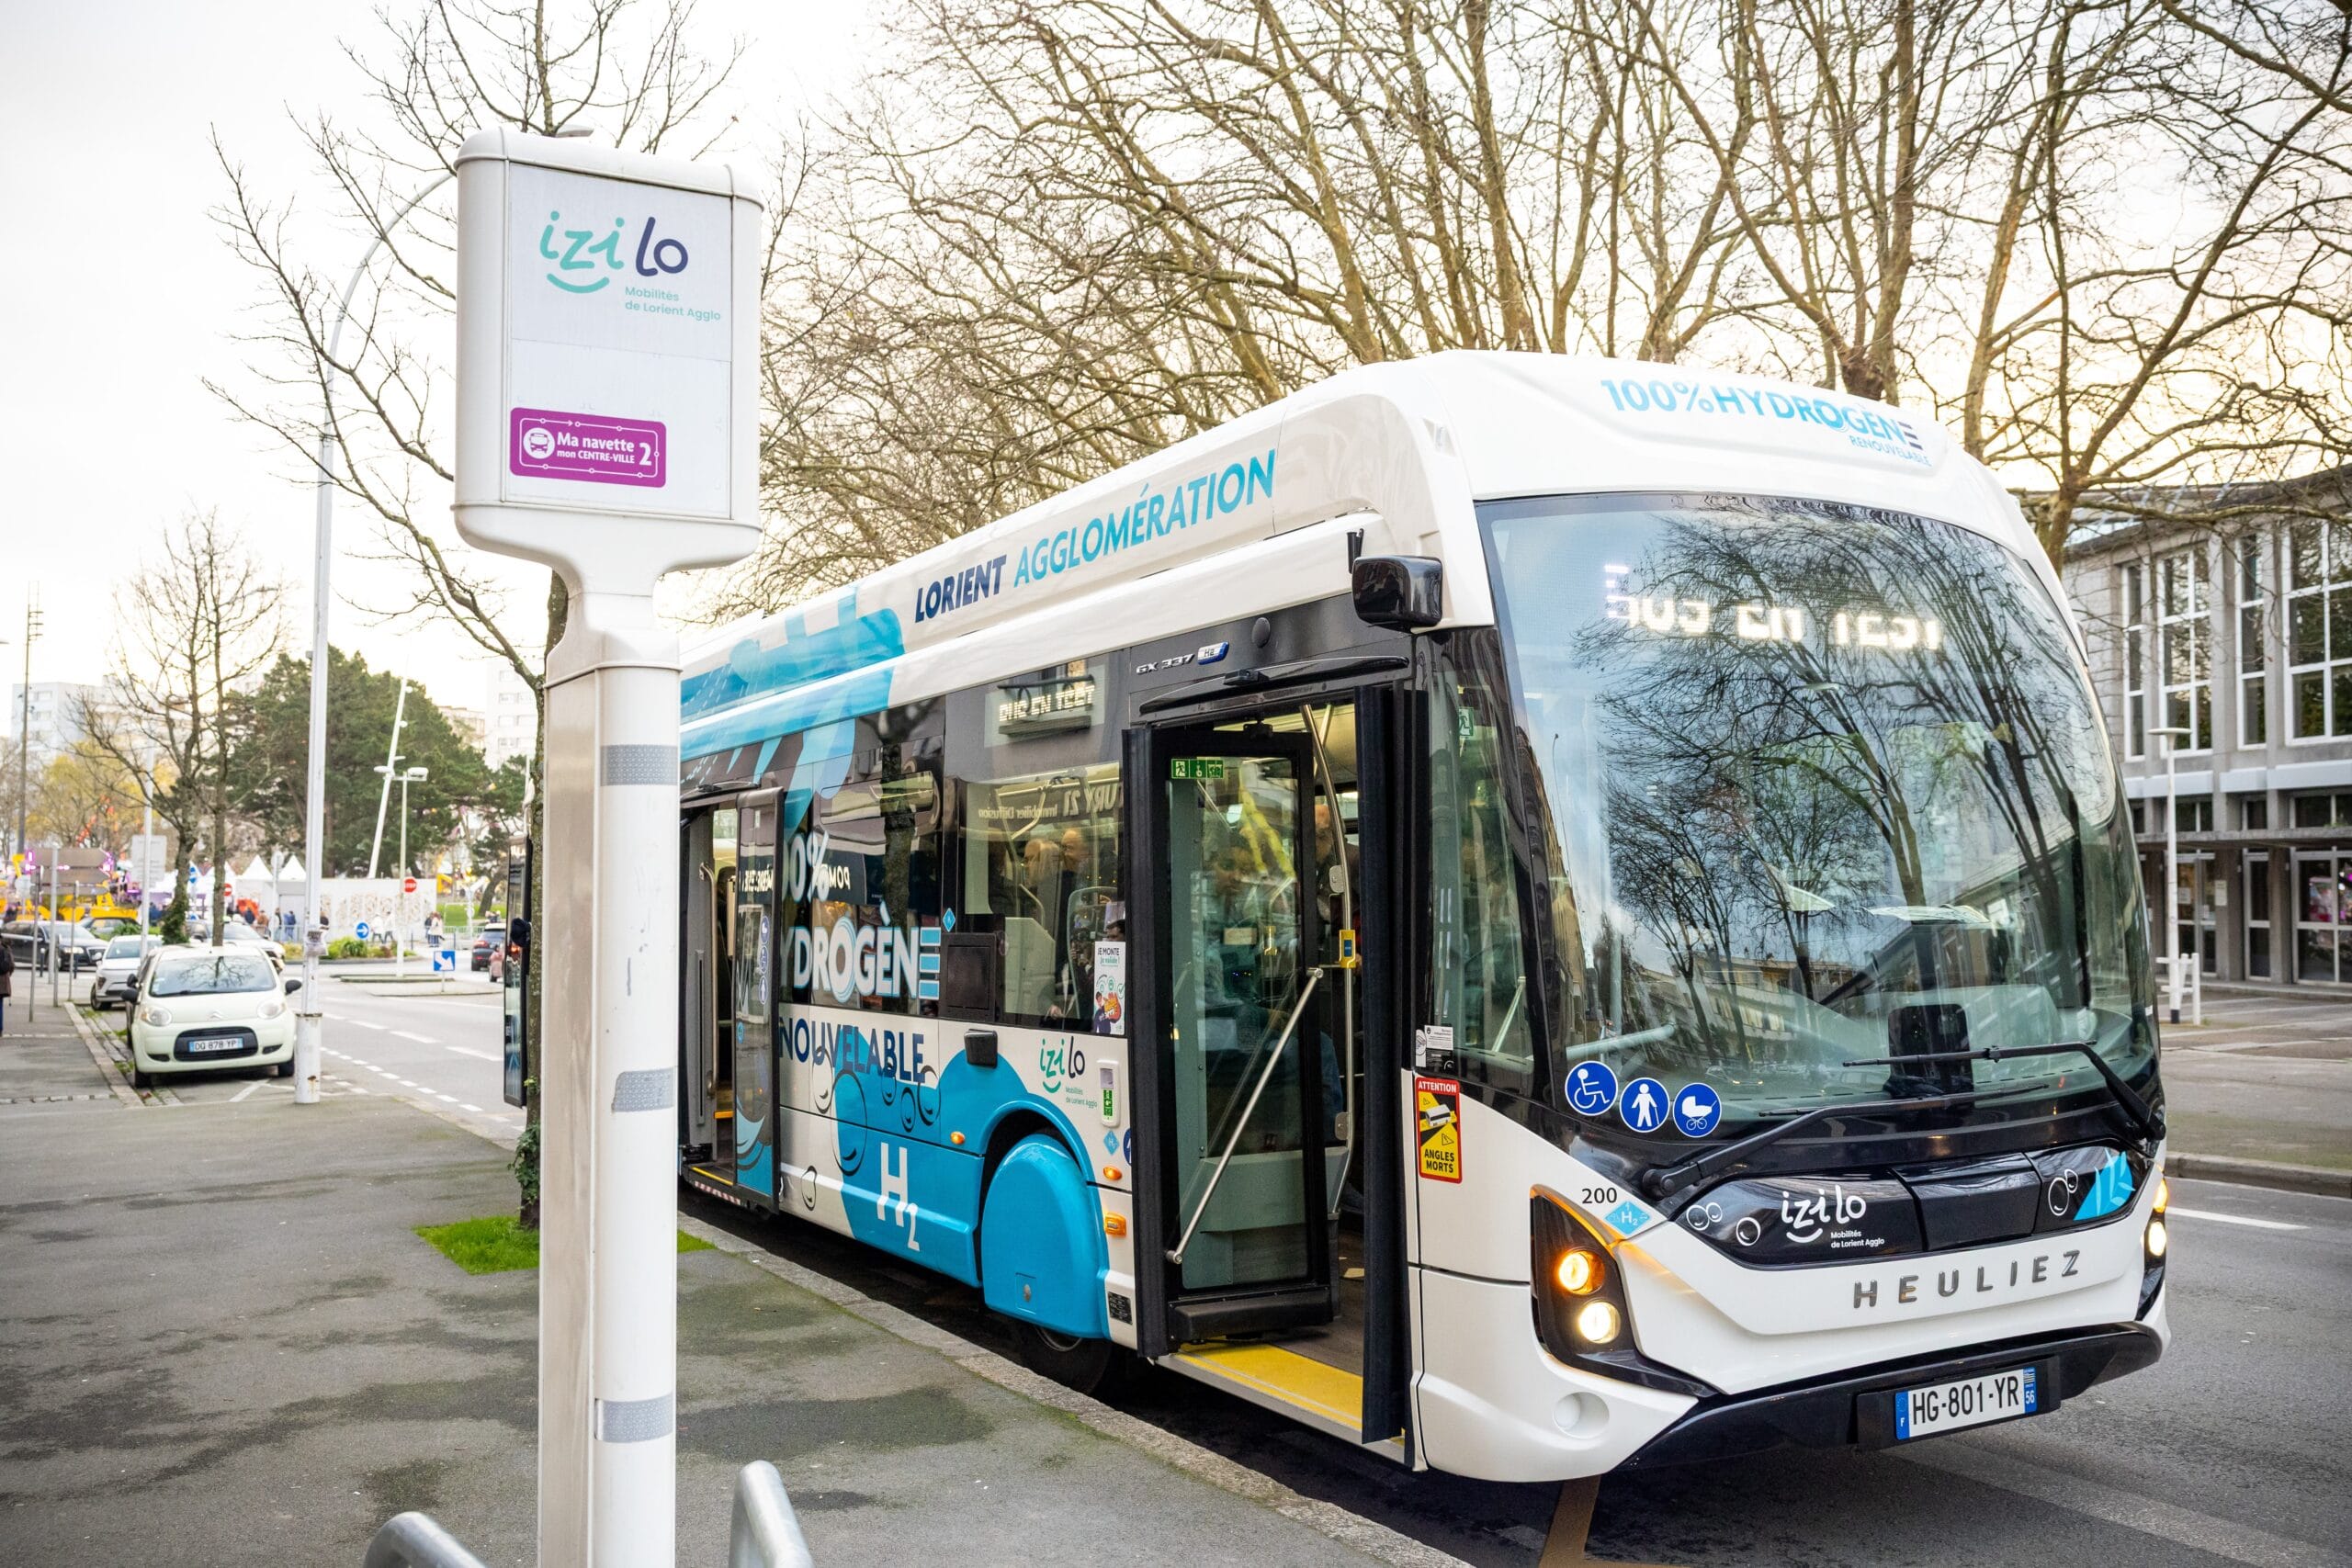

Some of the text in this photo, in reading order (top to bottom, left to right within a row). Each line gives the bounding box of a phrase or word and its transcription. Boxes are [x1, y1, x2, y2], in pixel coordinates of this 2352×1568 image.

[625, 286, 679, 301] Mobilités
[625, 299, 721, 321] de Lorient Agglo
[557, 432, 635, 452] Ma navette
[557, 450, 635, 464] mon CENTRE-VILLE
[639, 442, 652, 466] 2
[1849, 434, 1932, 468] RENOUVELABLE
[915, 448, 1276, 623] LORIENT AGGLOMÉRATION
[1136, 661, 1159, 675] GX
[1162, 653, 1194, 670] 337
[1418, 1080, 1457, 1093] ATTENTION
[1424, 1149, 1454, 1162] ANGLES
[1426, 1160, 1453, 1173] MORTS
[1581, 1188, 1617, 1203] 200
[1621, 1211, 1638, 1226] H2
[1831, 1230, 1862, 1239] Mobilités
[1841, 1239, 1864, 1248] Lorient
[1865, 1237, 1884, 1247] Agglo
[1853, 1249, 2080, 1309] HEULIEZ
[1900, 1376, 2035, 1427] F HG-801-YR 56
